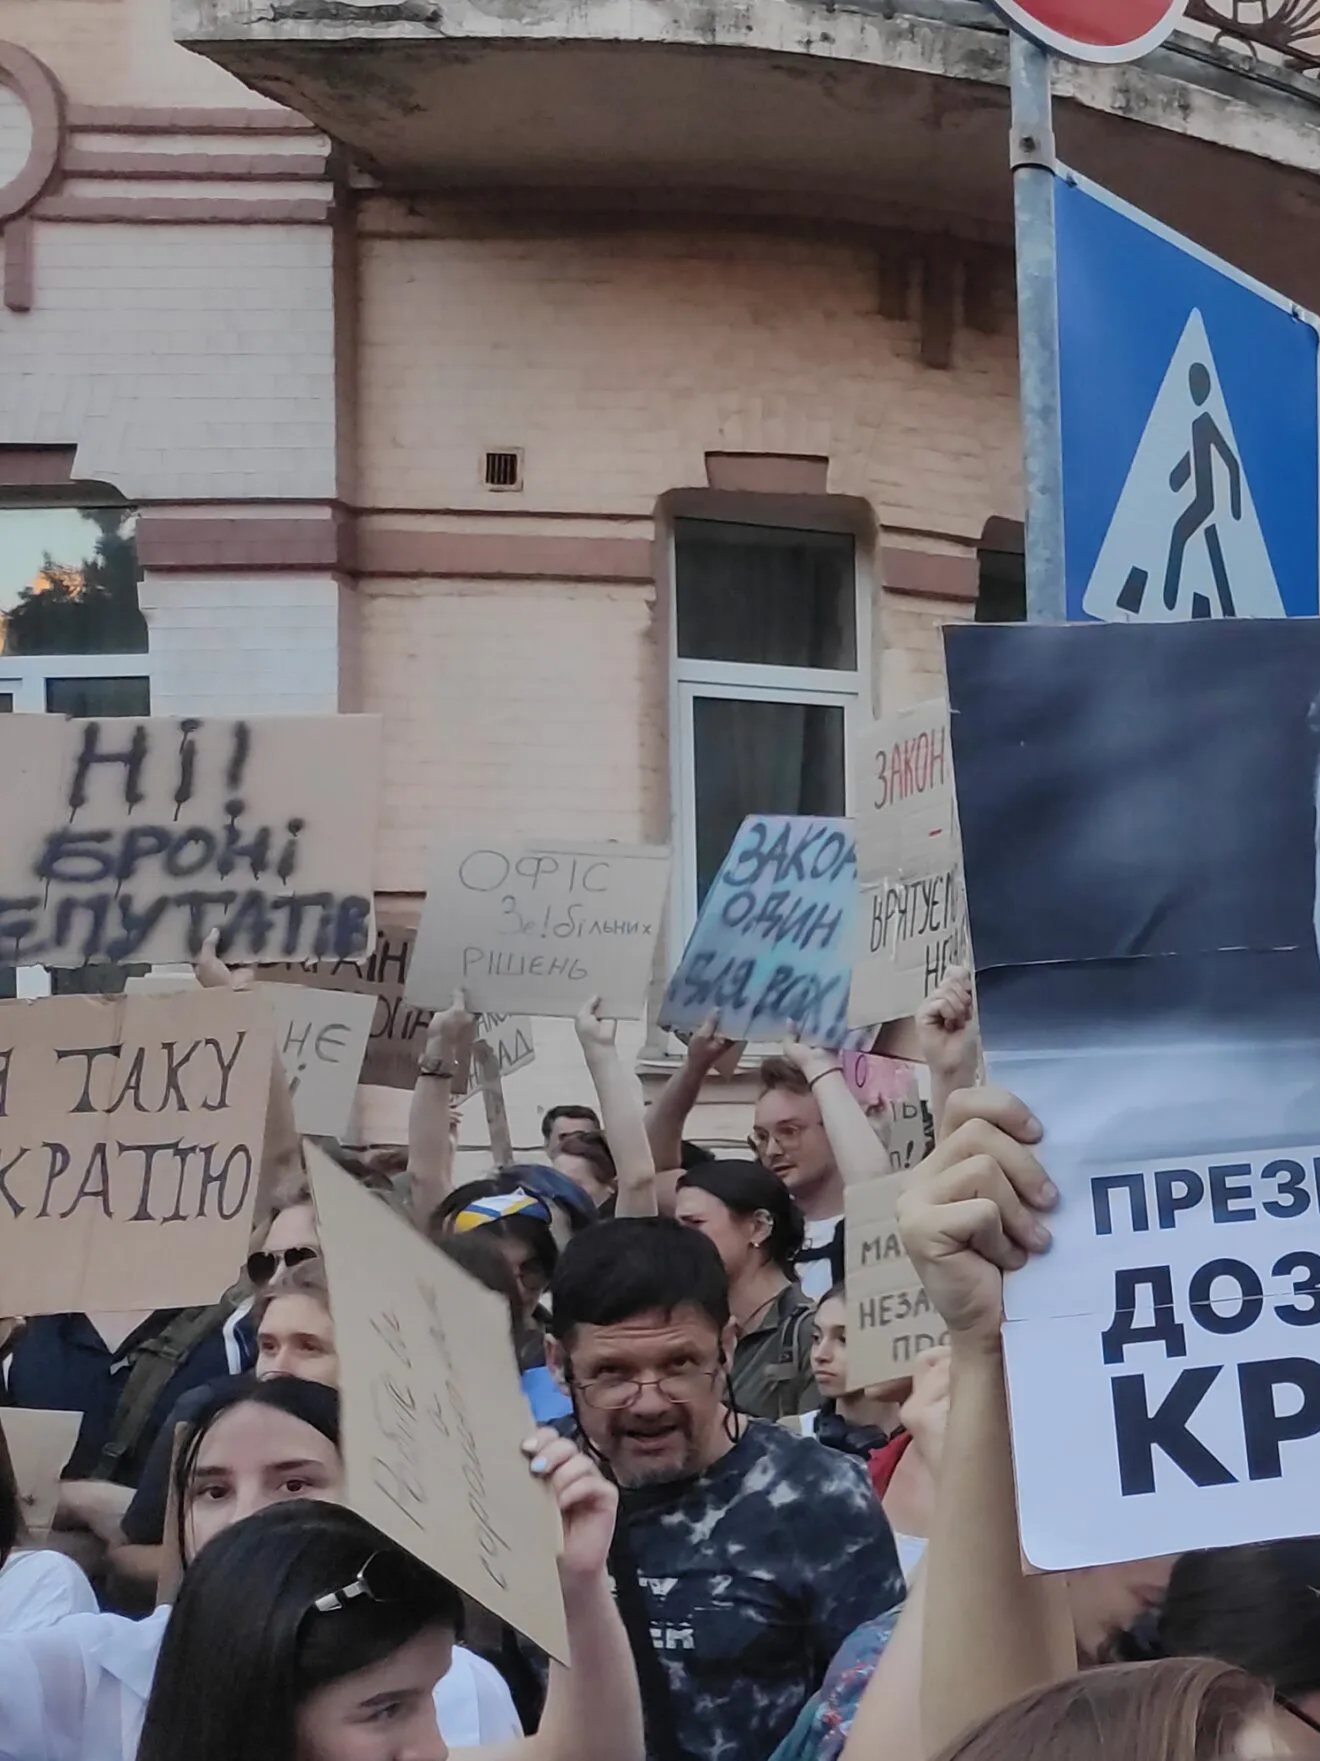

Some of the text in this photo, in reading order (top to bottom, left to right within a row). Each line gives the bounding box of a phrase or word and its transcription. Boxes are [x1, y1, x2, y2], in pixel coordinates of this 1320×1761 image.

[874, 726, 946, 809] ЗАКОН
[722, 890, 843, 951] ОДИН
[53, 1031, 248, 1114] ТАКУ
